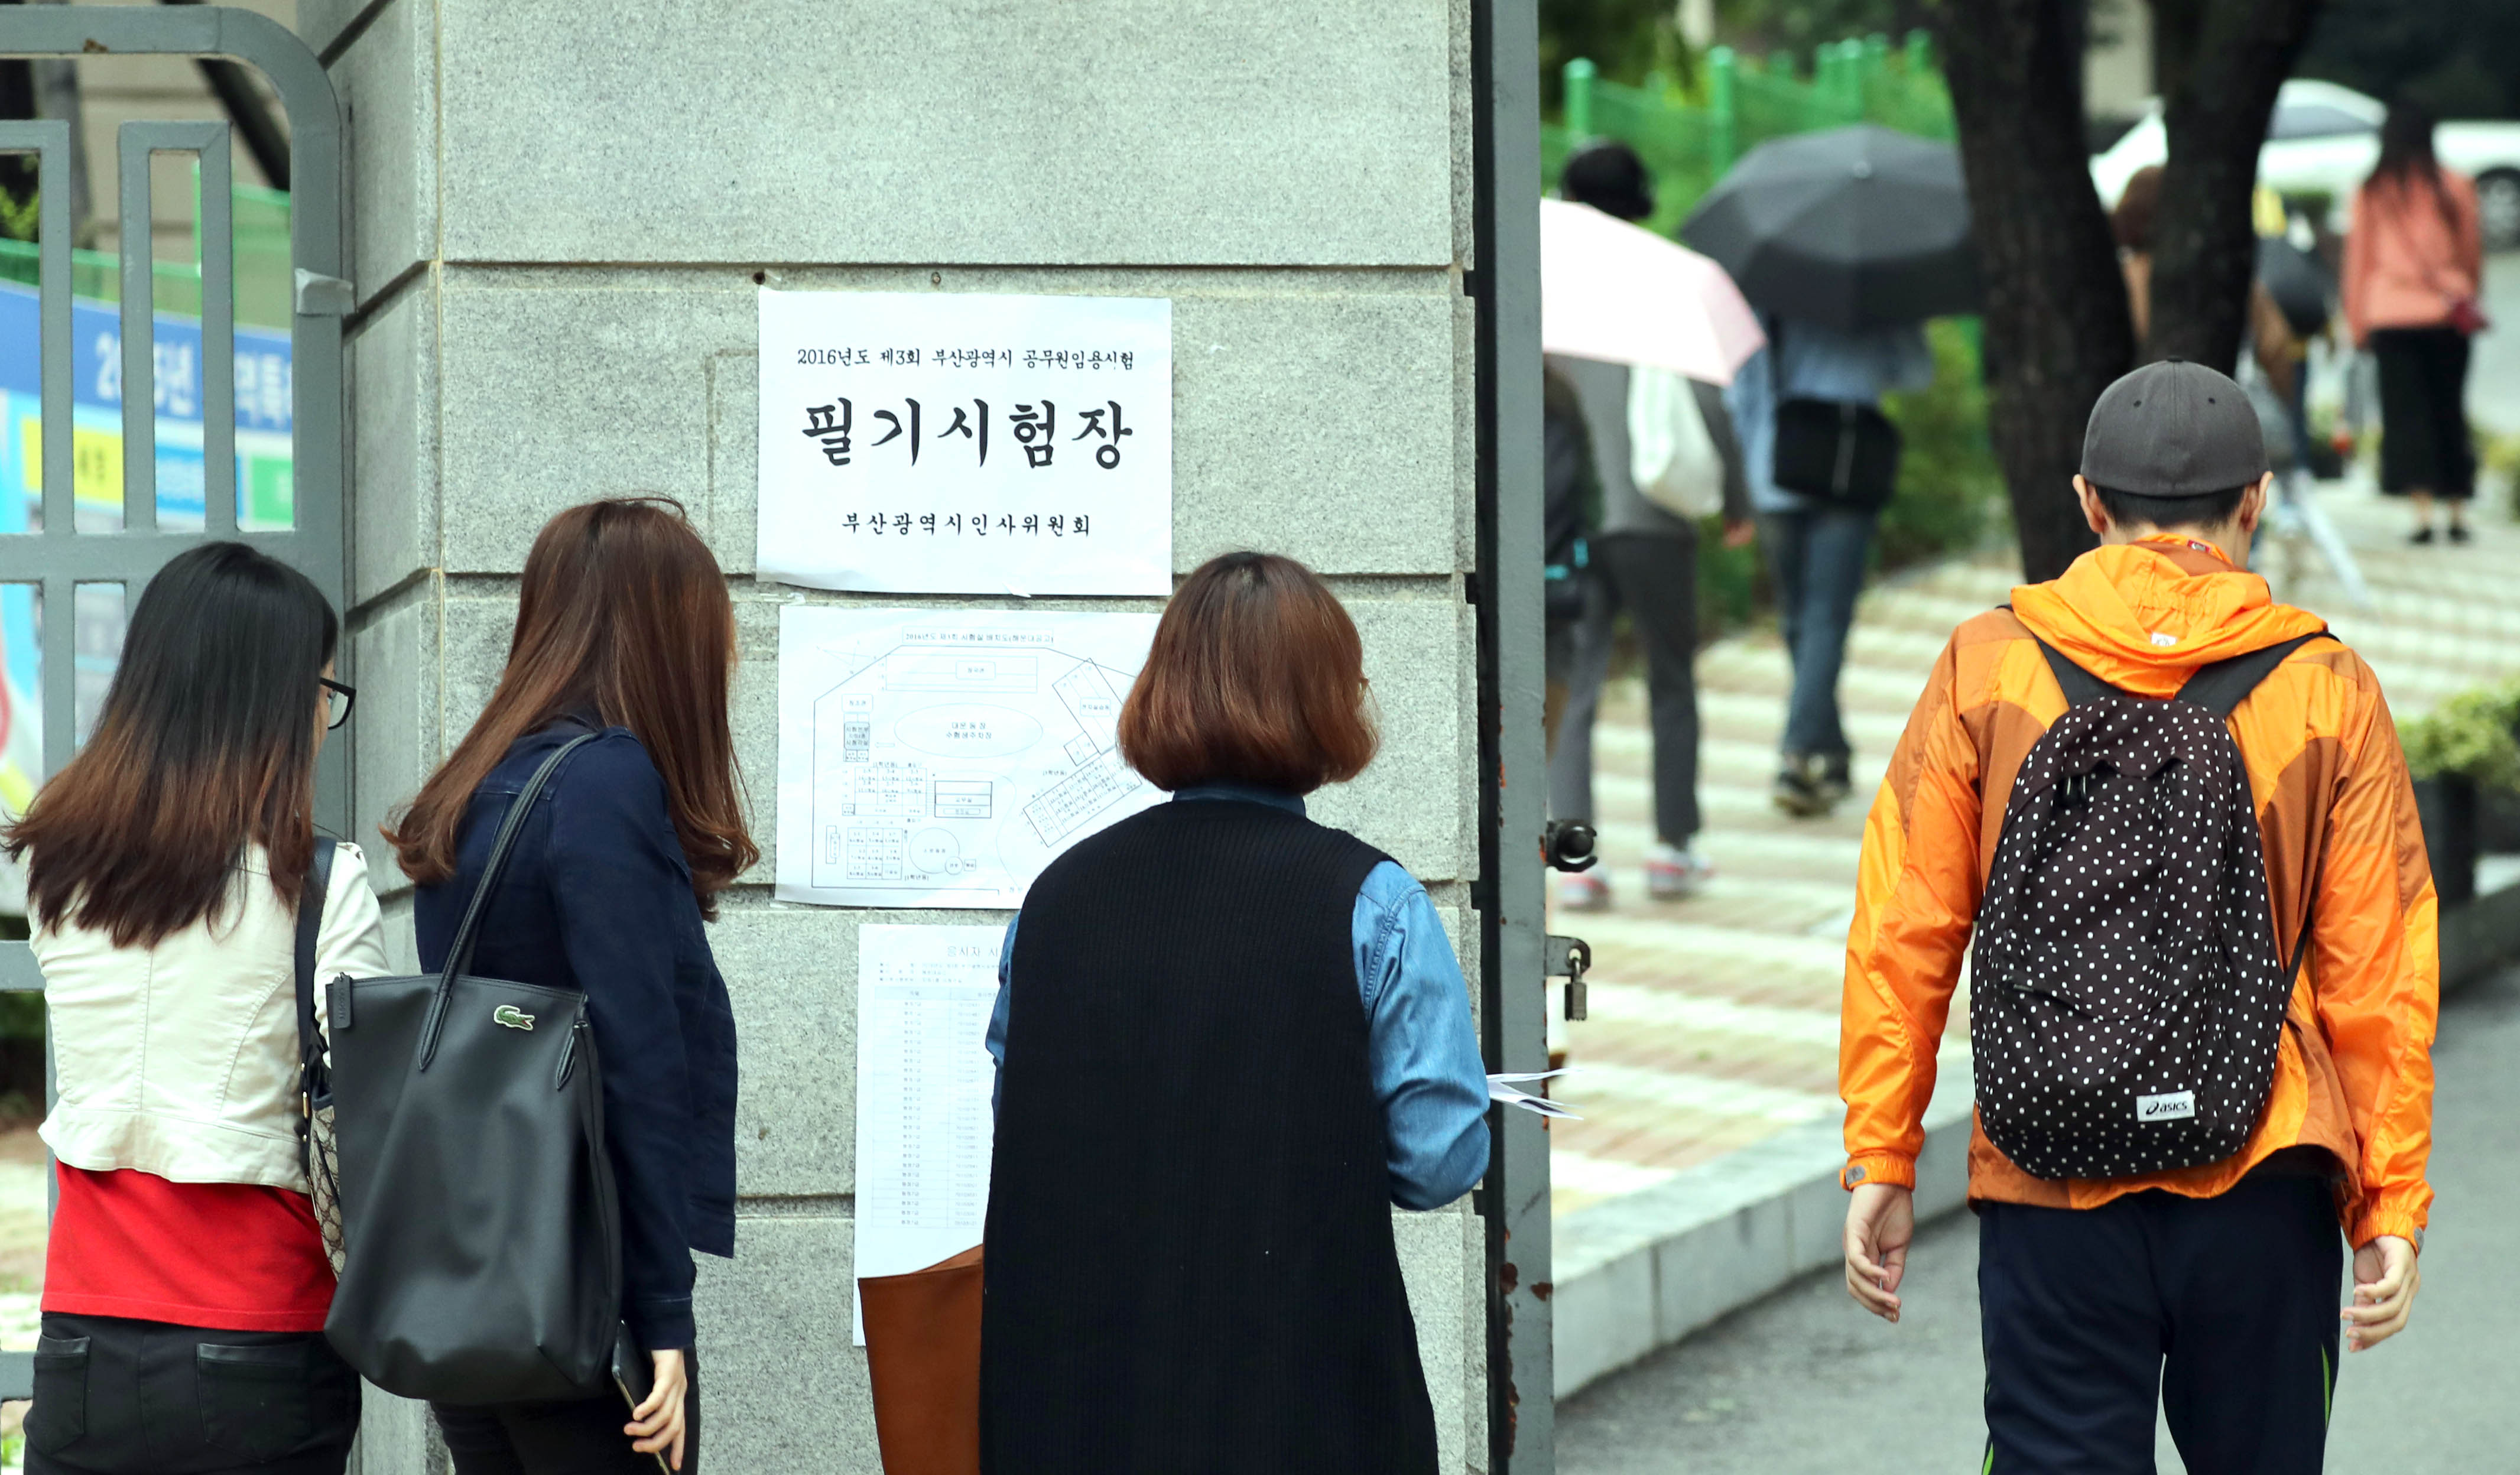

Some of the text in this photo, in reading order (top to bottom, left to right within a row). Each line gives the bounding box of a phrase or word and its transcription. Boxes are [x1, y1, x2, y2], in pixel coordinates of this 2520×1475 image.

[797, 347, 1133, 371] 2016년도 제3회 부산광역시 공무원임용시험
[802, 397, 1133, 470] 필기시험장
[842, 512, 1089, 537] 부산광역시인사위원회
[2159, 1101, 2188, 1113] asics
